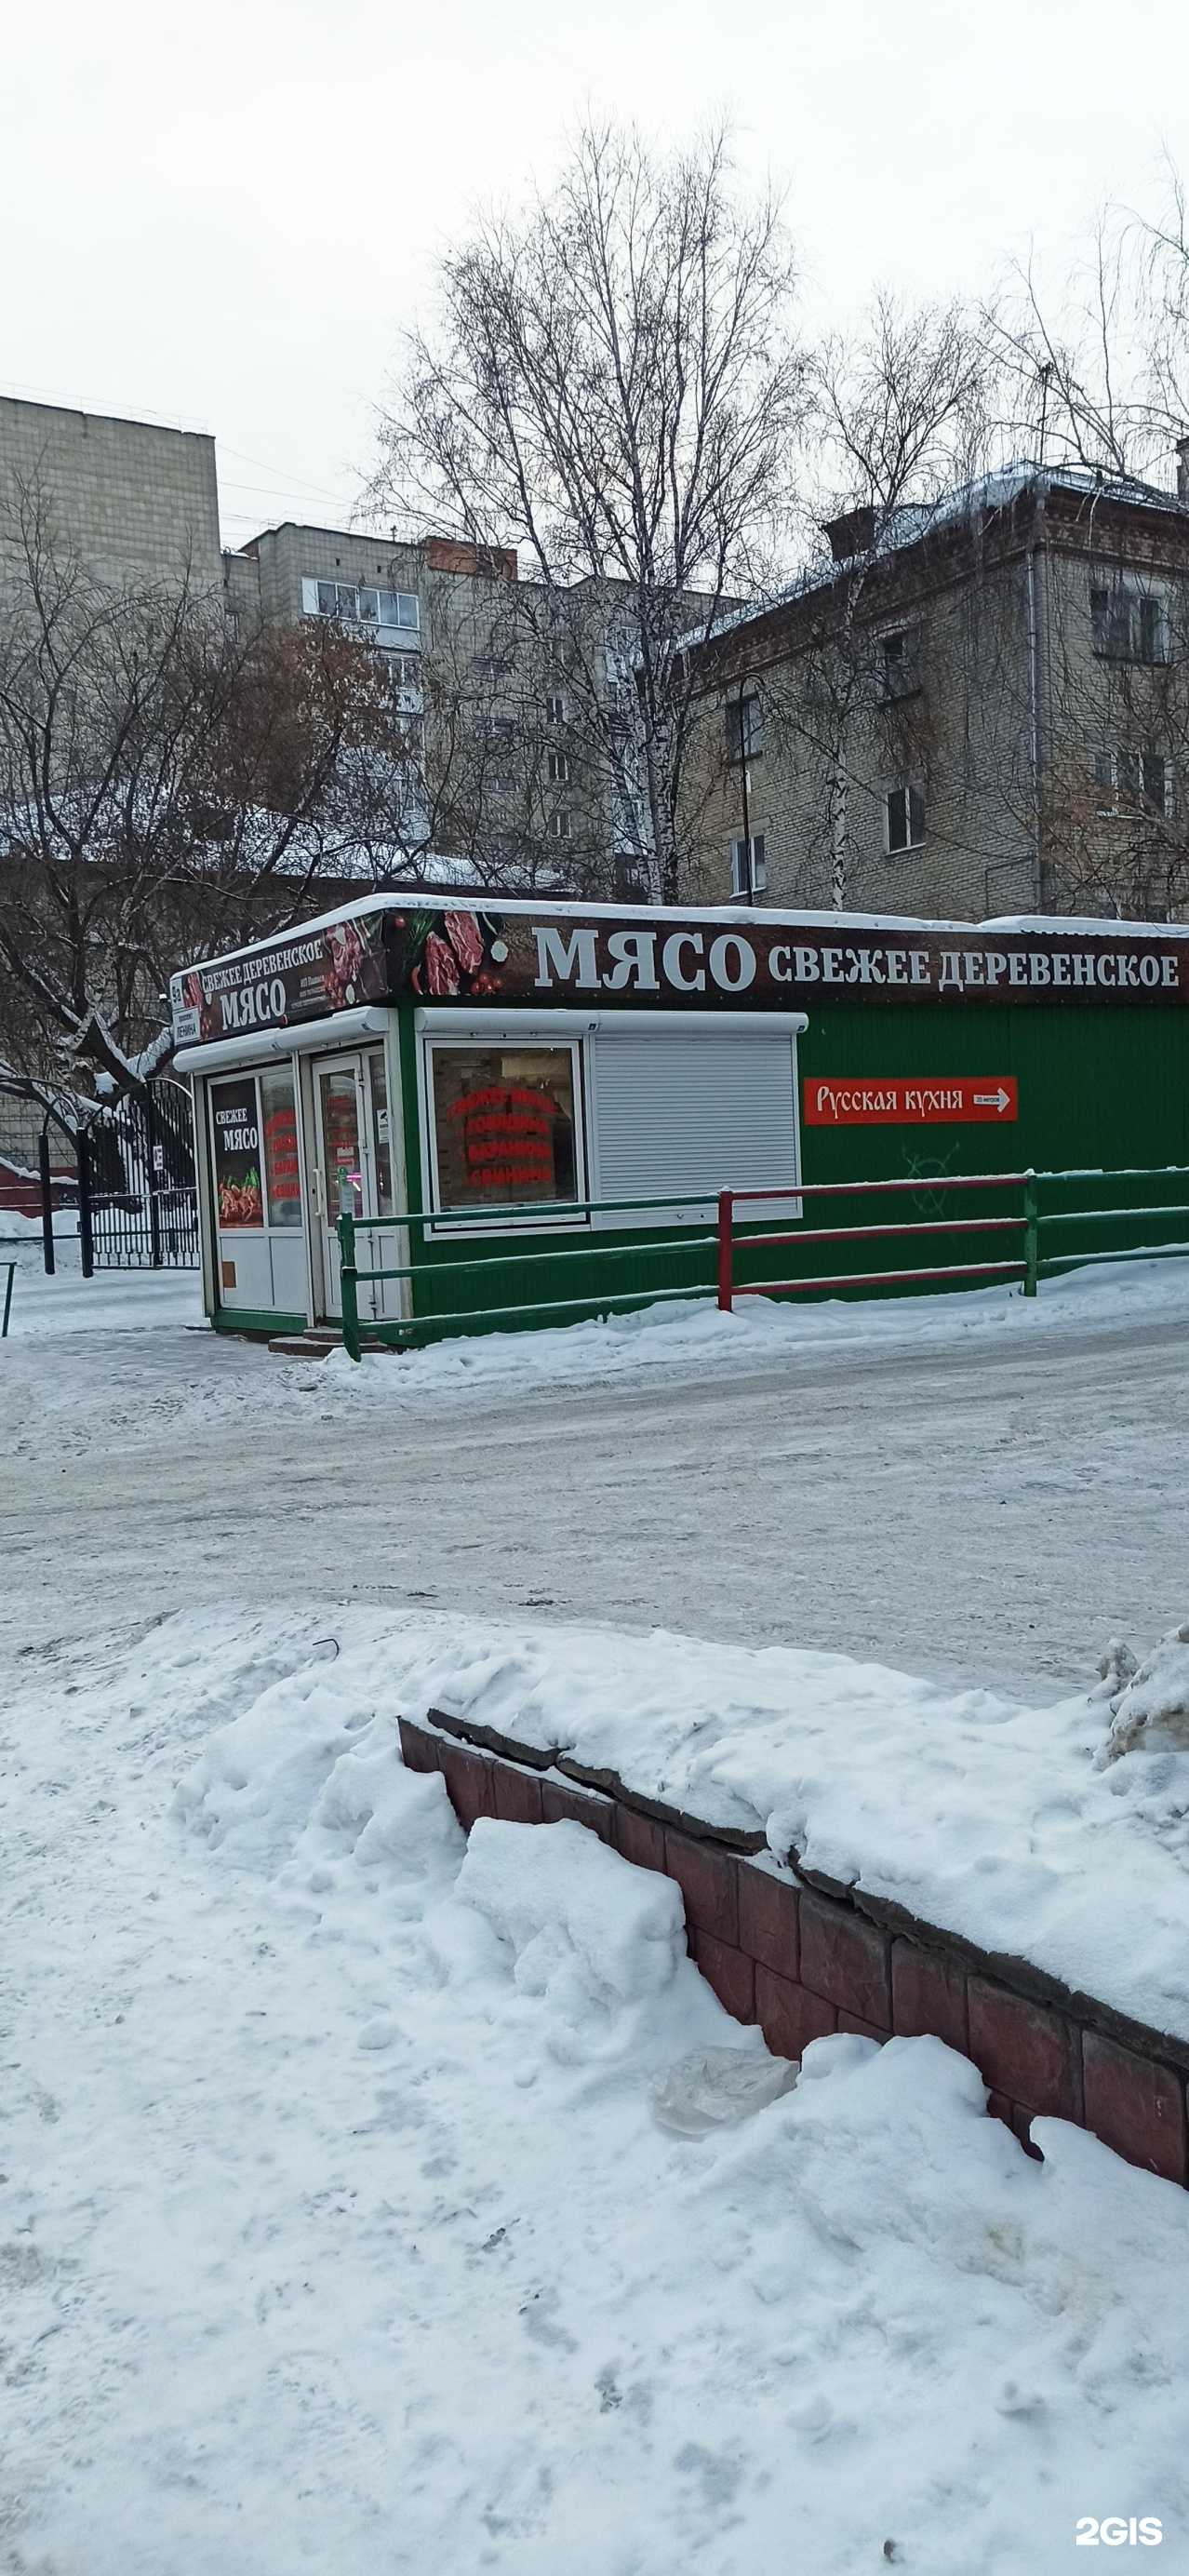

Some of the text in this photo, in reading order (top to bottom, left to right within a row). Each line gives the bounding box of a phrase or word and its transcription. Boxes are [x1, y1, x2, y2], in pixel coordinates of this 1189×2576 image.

[202, 939, 324, 993] СВЕЖЕЕ ДЕРЕВЕНСКОЕ
[531, 927, 1180, 992] МЯСО СВЕЖЕЕ ДЕРЕВЕНСКОЕ
[220, 978, 287, 1031] МЯСО
[216, 1107, 248, 1125] СВЕЖЕЕ
[817, 1085, 963, 1119] Русская кухня
[223, 1127, 259, 1151] МЯСО
